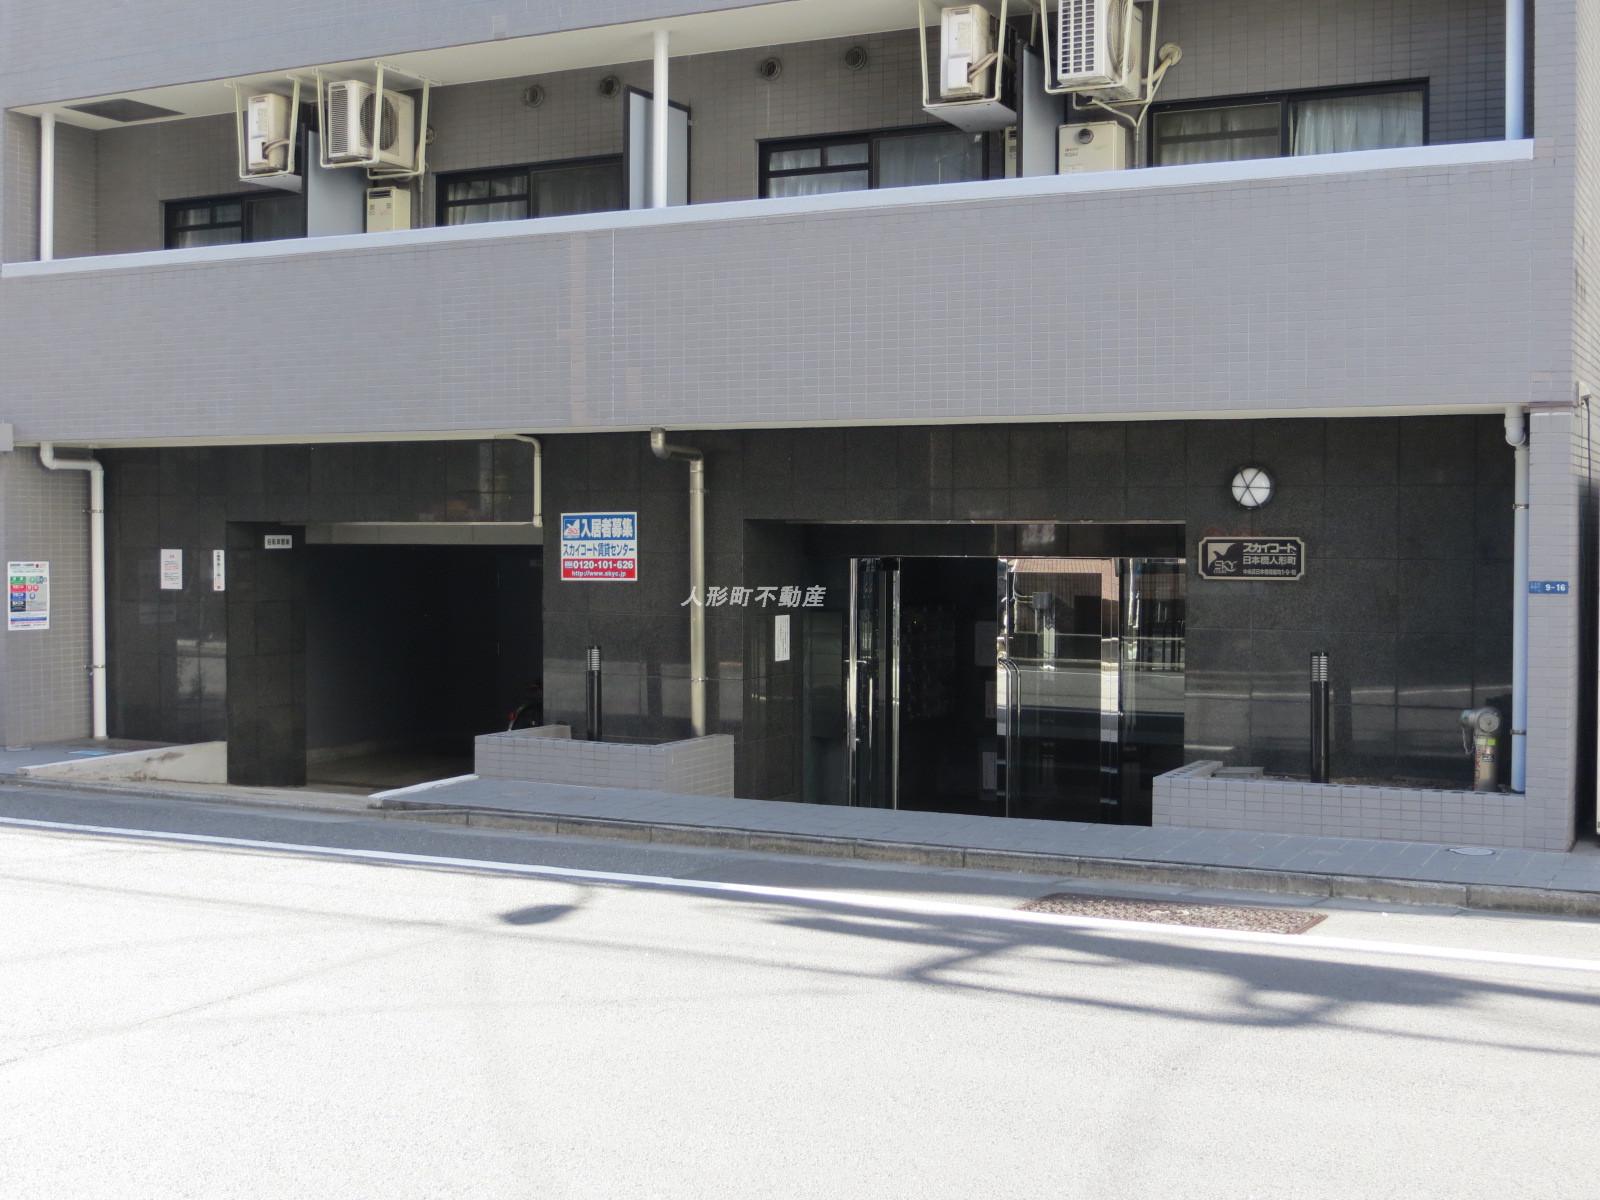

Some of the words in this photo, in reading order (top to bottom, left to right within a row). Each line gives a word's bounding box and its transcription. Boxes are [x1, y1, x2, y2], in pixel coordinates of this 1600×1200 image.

[581, 518, 632, 538] 入居者募集
[562, 543, 635, 557] スカイコート賃貸センター
[1242, 542, 1297, 553] スカイコート
[1242, 555, 1297, 566] 日本橋人形町
